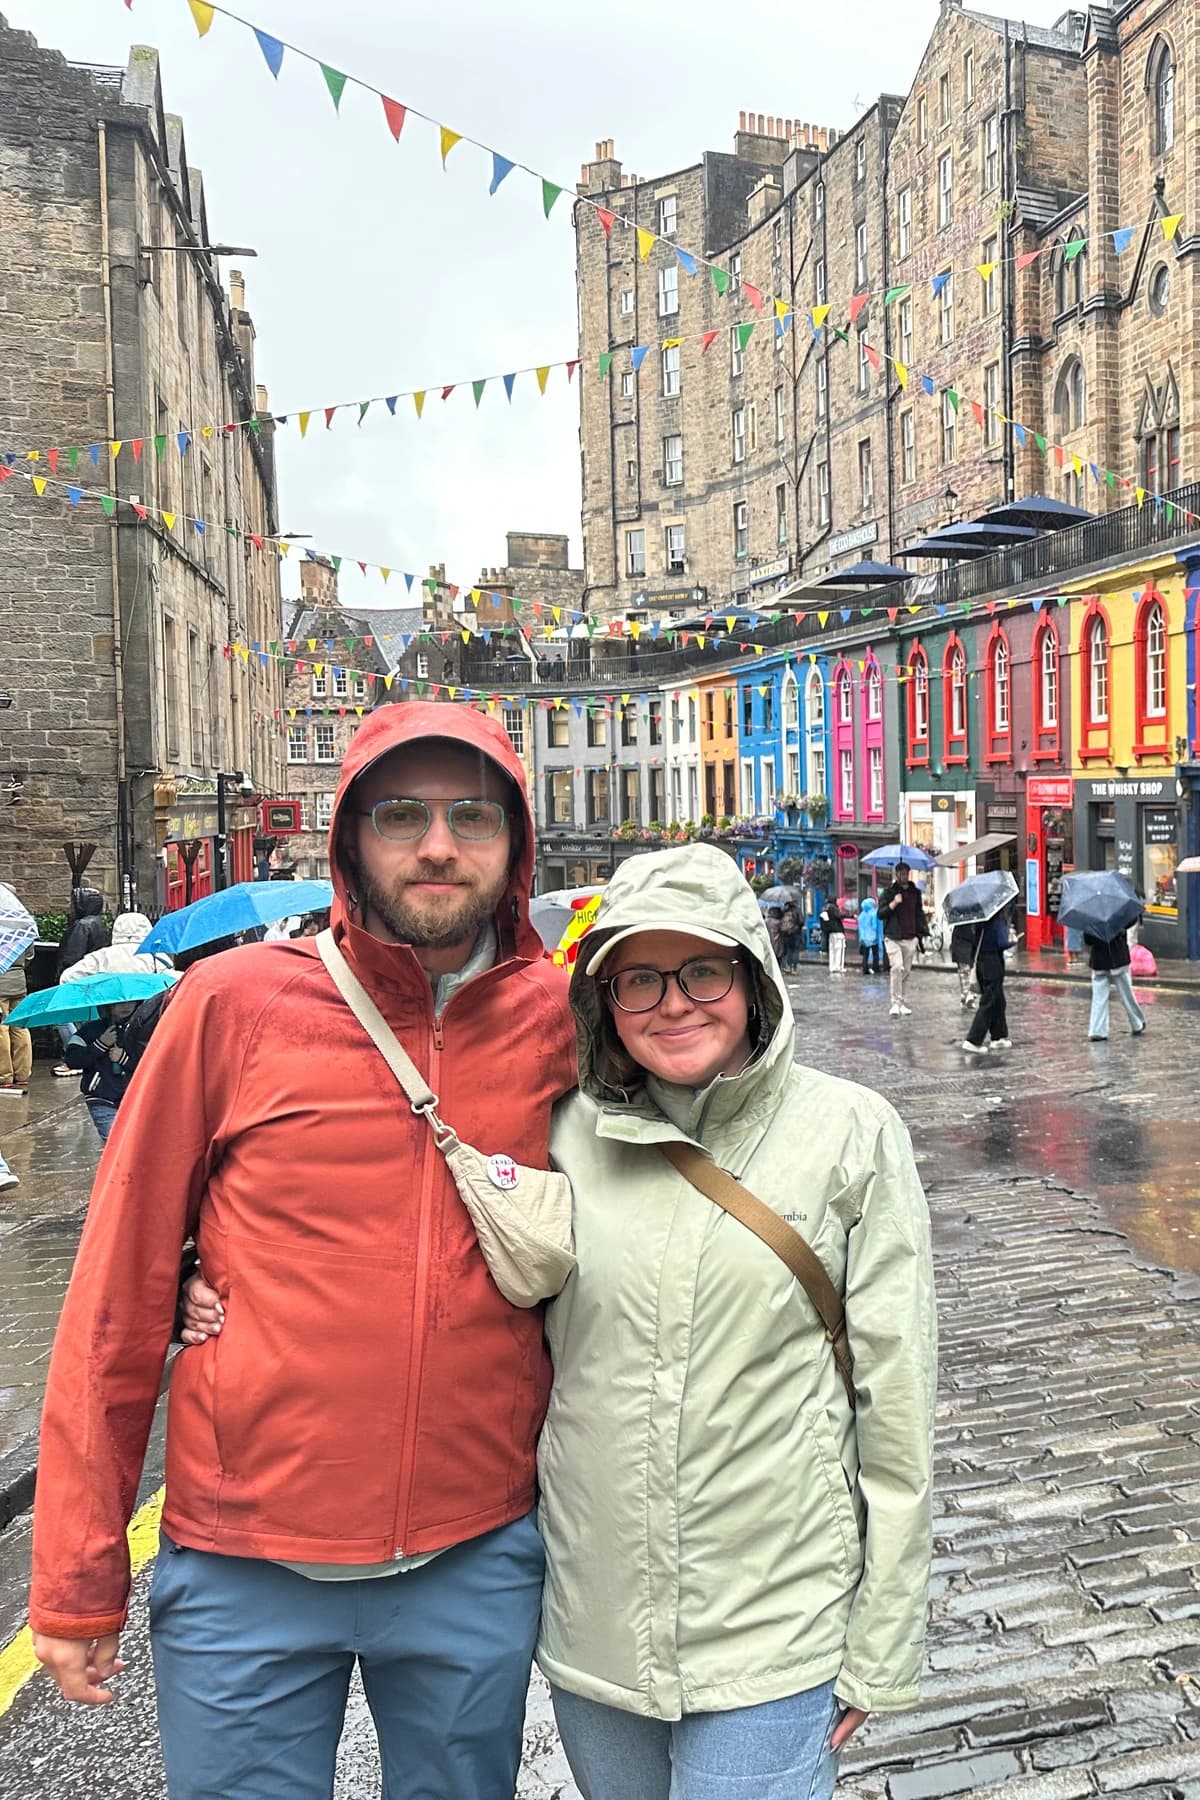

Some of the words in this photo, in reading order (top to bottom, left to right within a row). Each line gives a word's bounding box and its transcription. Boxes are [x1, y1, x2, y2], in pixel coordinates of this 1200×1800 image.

[1091, 783, 1107, 796] THE
[1107, 782, 1139, 796] WHISKY
[1139, 782, 1163, 795] SHOP
[780, 1210, 808, 1222] mbia
